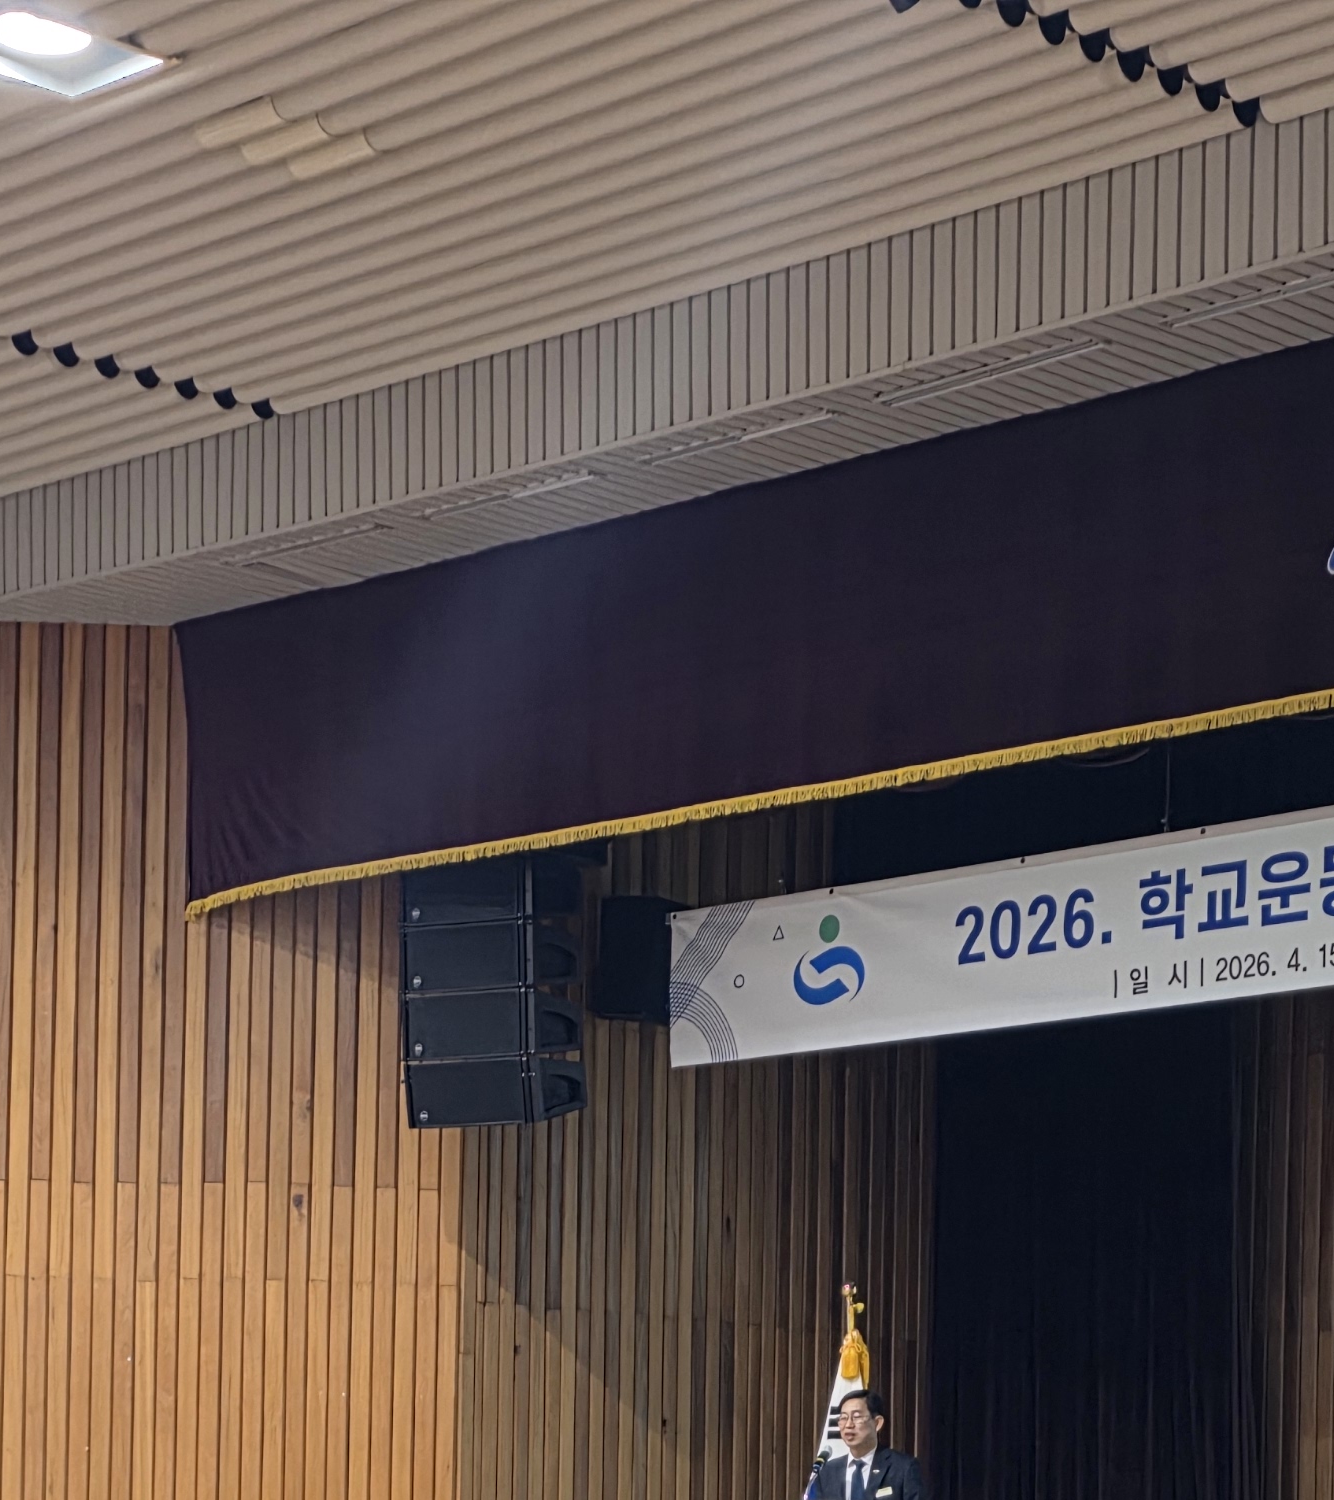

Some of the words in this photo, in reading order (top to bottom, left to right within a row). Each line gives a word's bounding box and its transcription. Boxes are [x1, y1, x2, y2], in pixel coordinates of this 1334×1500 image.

[954, 889, 1113, 967] 2026.
[1215, 951, 1278, 984] 2026.
[1286, 946, 1309, 973] 4.
